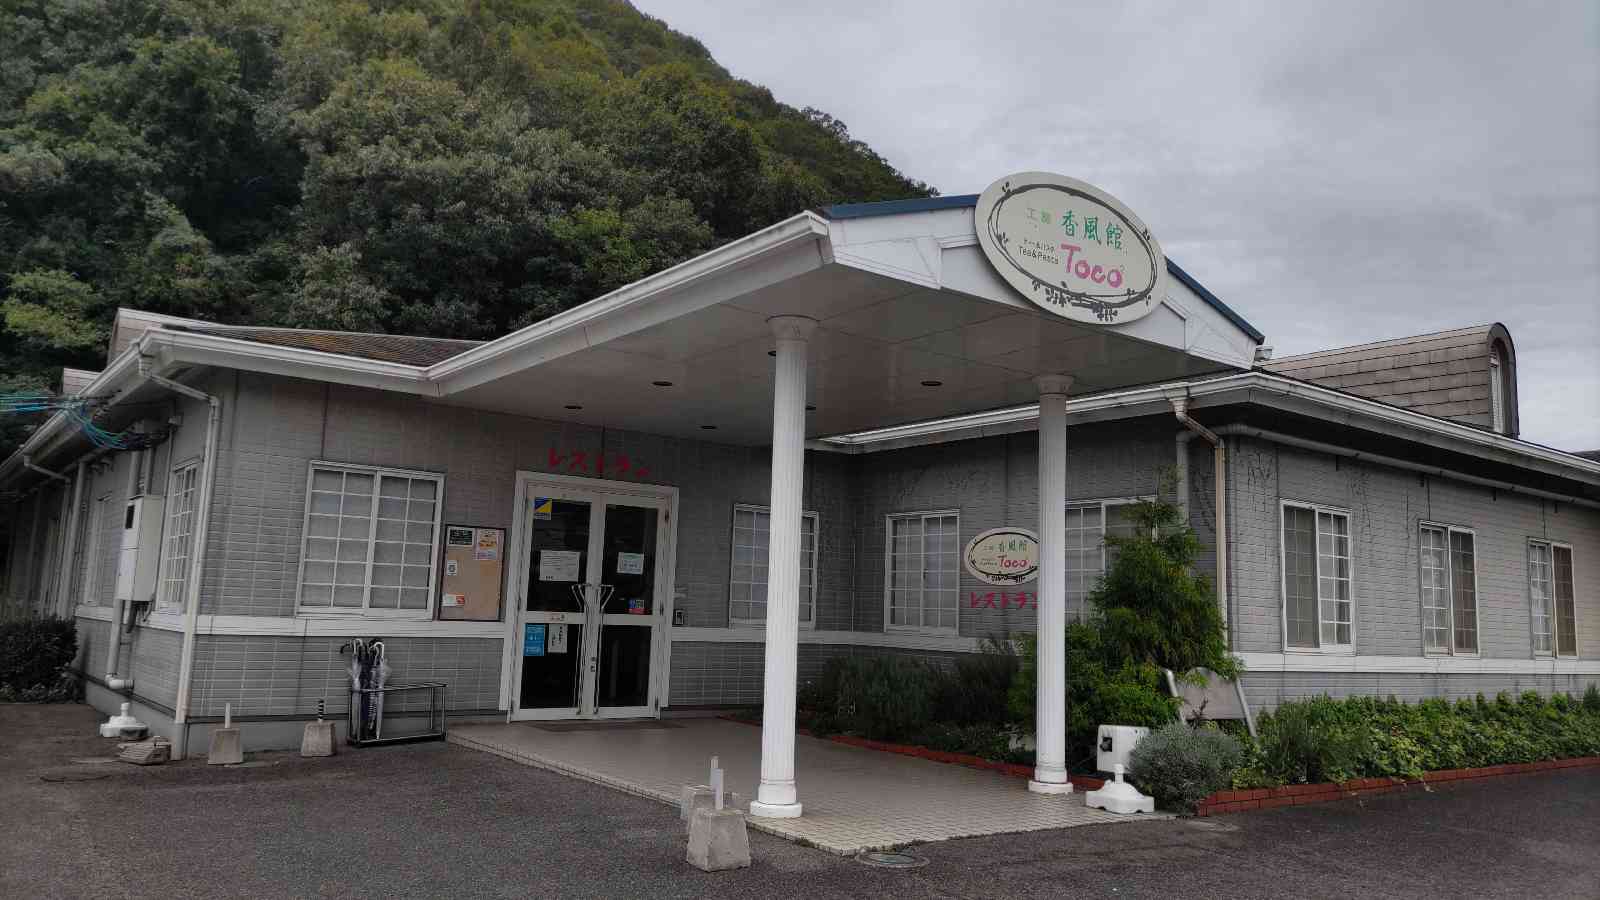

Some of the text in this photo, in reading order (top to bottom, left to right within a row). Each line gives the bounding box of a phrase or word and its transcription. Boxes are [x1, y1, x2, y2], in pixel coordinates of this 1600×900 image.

[1061, 209, 1124, 249] 香風館
[1061, 243, 1123, 288] Toco
[548, 448, 649, 477] レストラン
[997, 554, 1027, 568] Toco
